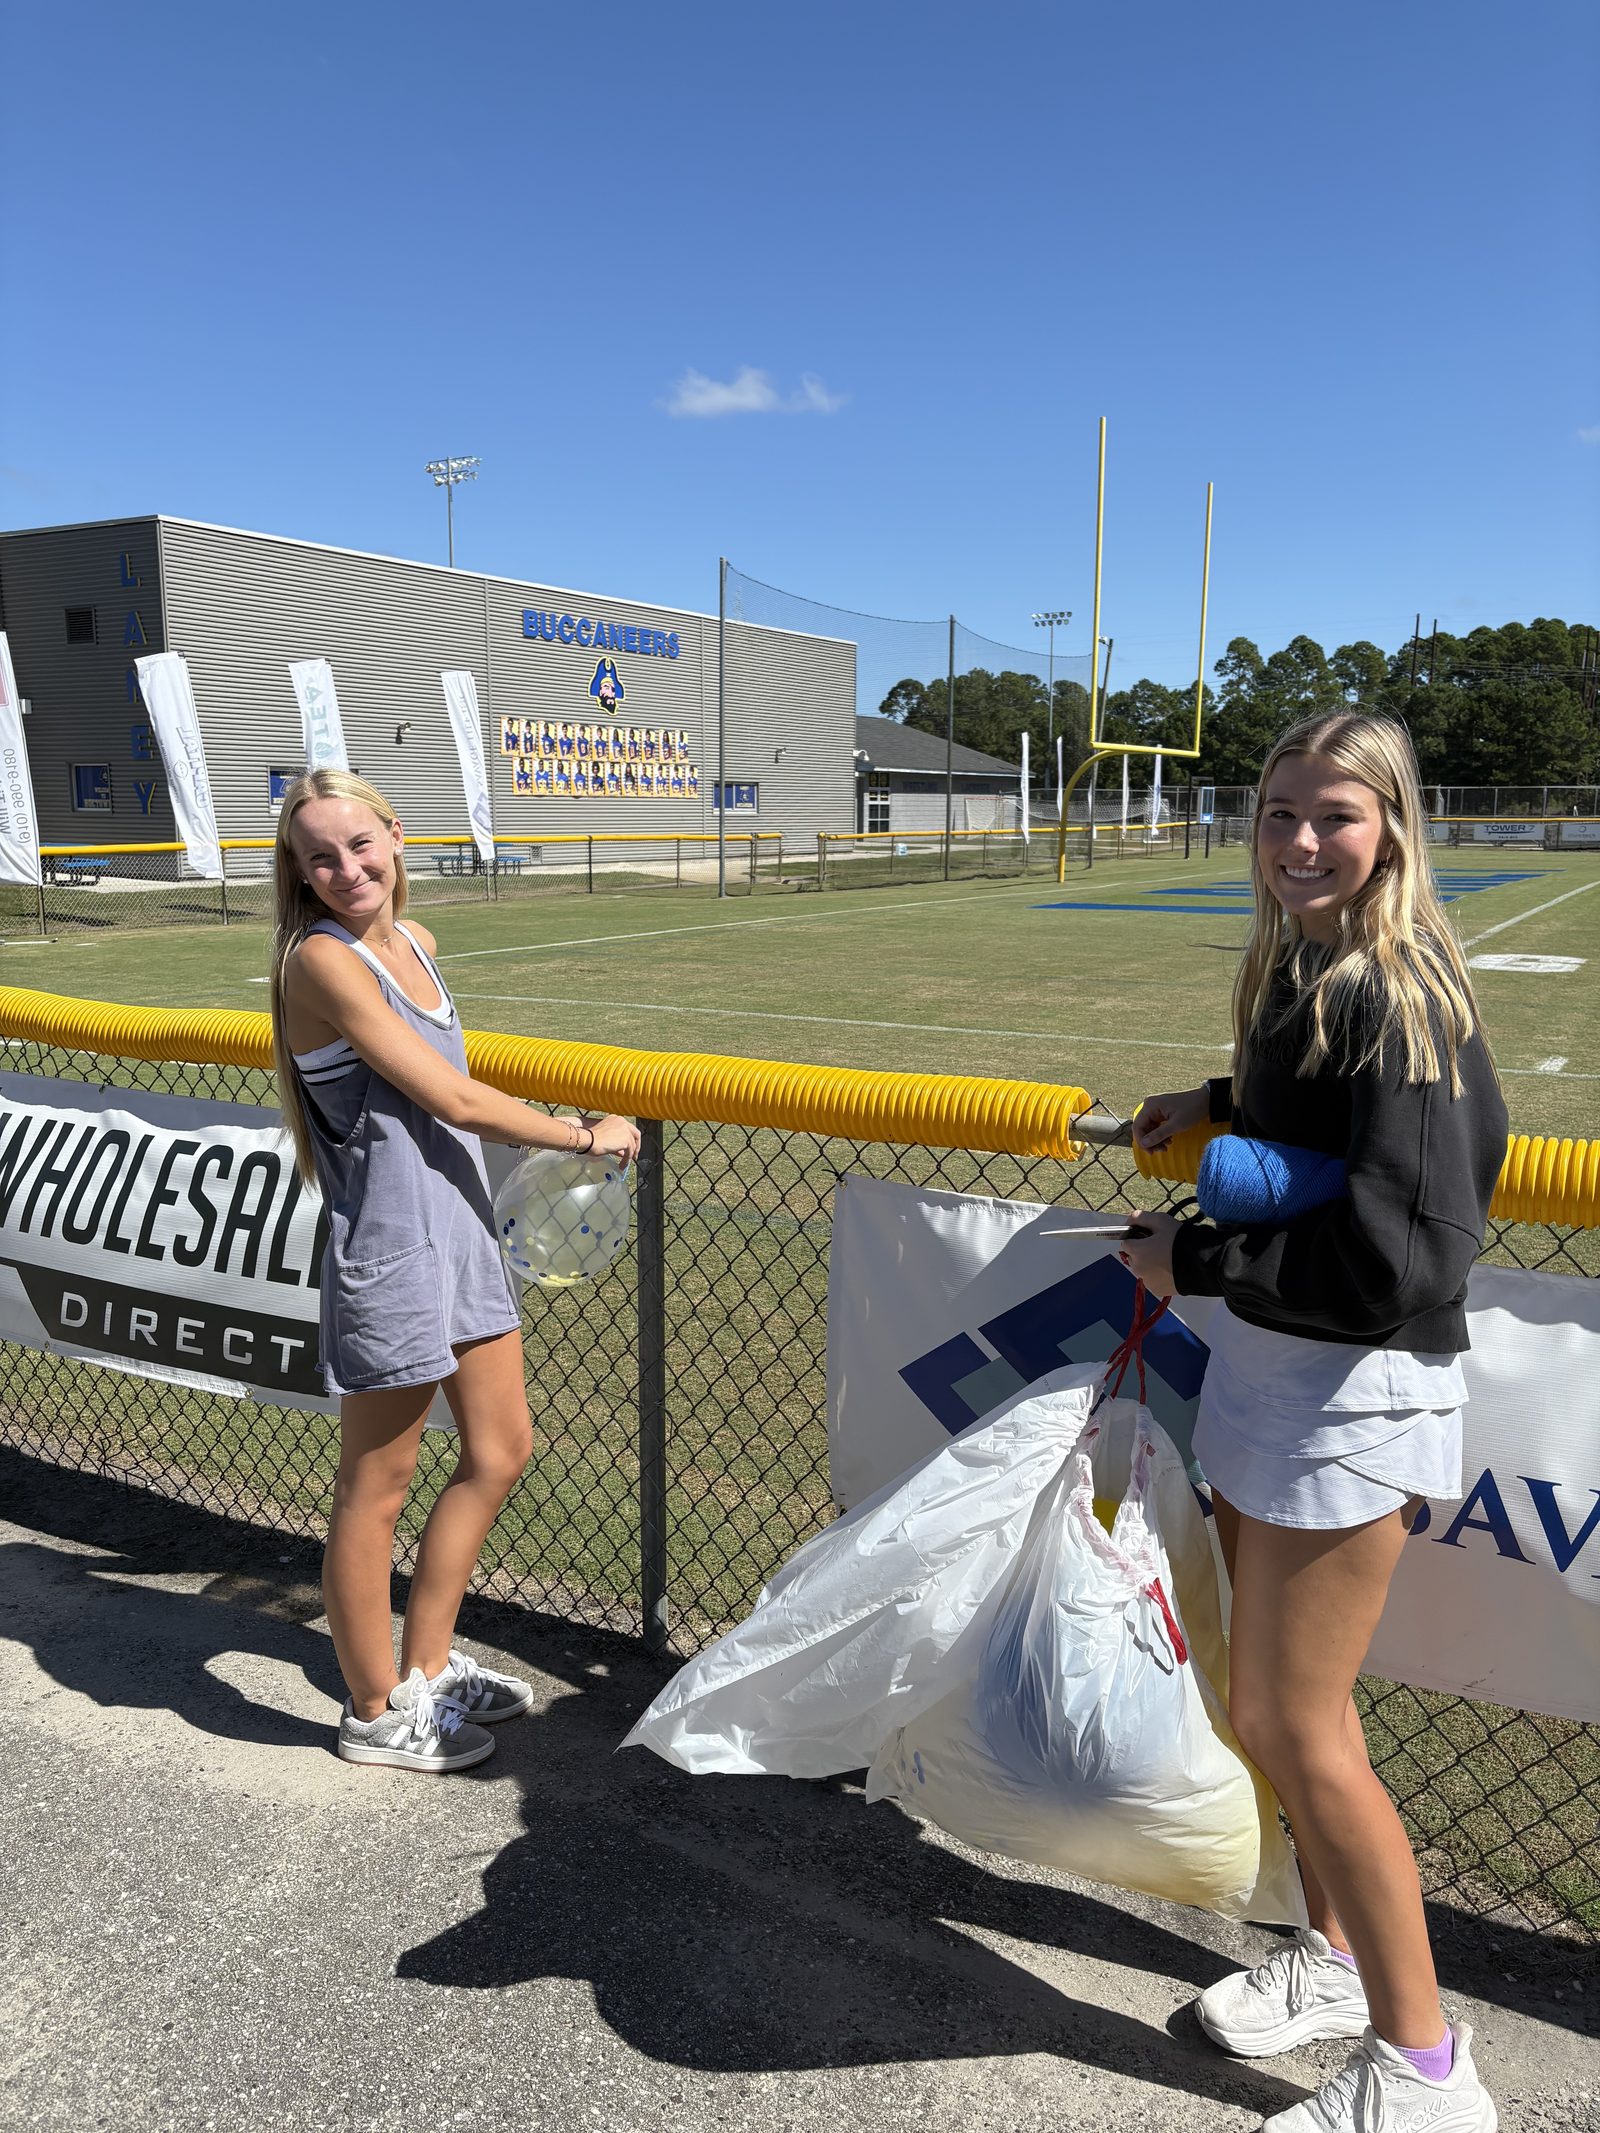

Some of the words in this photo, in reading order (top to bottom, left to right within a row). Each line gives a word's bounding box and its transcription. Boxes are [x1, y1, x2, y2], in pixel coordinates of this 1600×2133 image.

[522, 609, 681, 659] BUCCANEERS
[1484, 824, 1526, 832] TOWER
[0, 1111, 331, 1290] WHOLESAL
[60, 1292, 305, 1374] DIRECT
